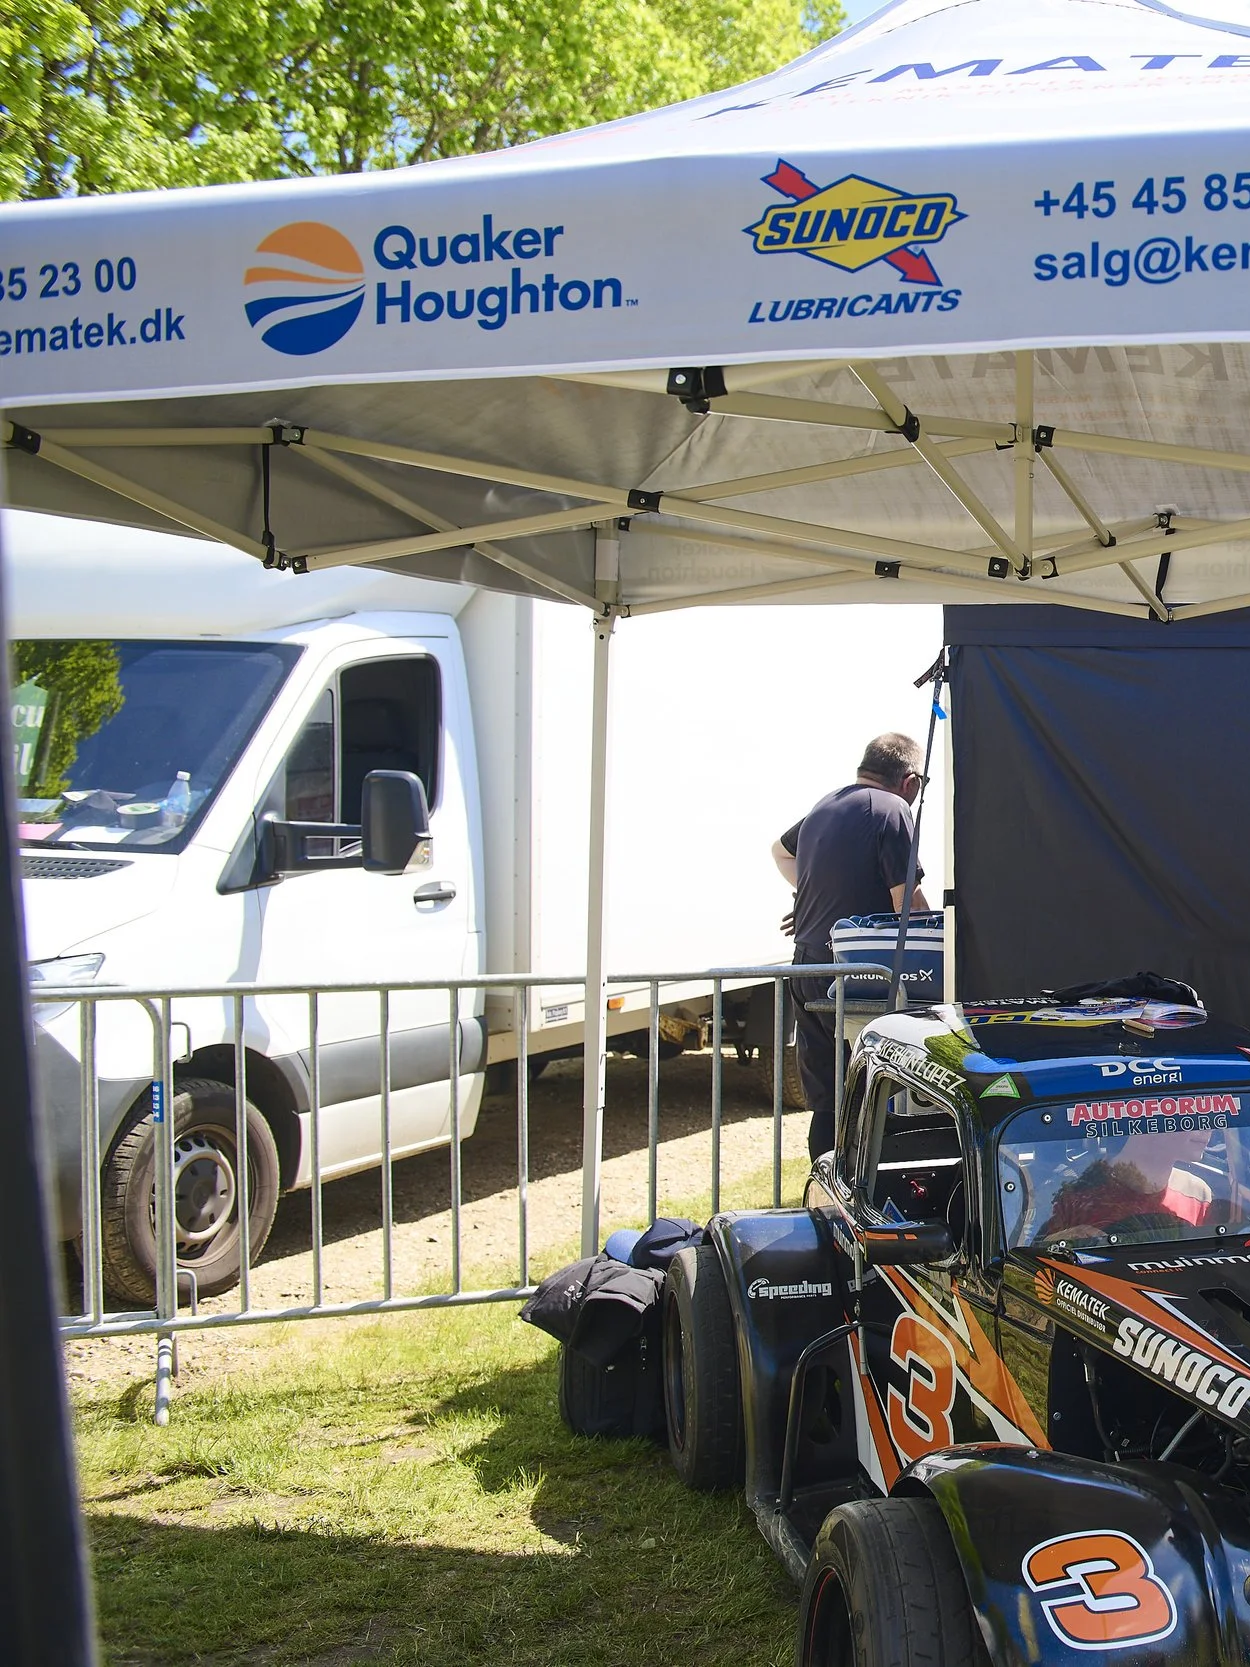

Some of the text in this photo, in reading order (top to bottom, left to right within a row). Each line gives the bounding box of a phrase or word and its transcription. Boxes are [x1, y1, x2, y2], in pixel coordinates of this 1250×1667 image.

[1034, 180, 1117, 219] +45
[1131, 176, 1188, 215] 45
[373, 213, 564, 271] Quaker
[762, 202, 948, 247] SUNOCO
[0, 256, 137, 302] 5 23 00
[376, 267, 622, 331] Houghton
[747, 289, 963, 323] LUBRICANTS
[915, 1058, 967, 1095] LOPEZ
[1092, 1057, 1181, 1078] DCC
[1133, 1070, 1183, 1087] energi
[1070, 1094, 1240, 1127] AUTOFORUM
[1086, 1113, 1228, 1139] SILKEBORG
[758, 1280, 832, 1300] speeding
[1056, 1279, 1111, 1321] KEMATEK
[887, 1310, 957, 1464] 3
[1021, 1528, 1180, 1652] 3
